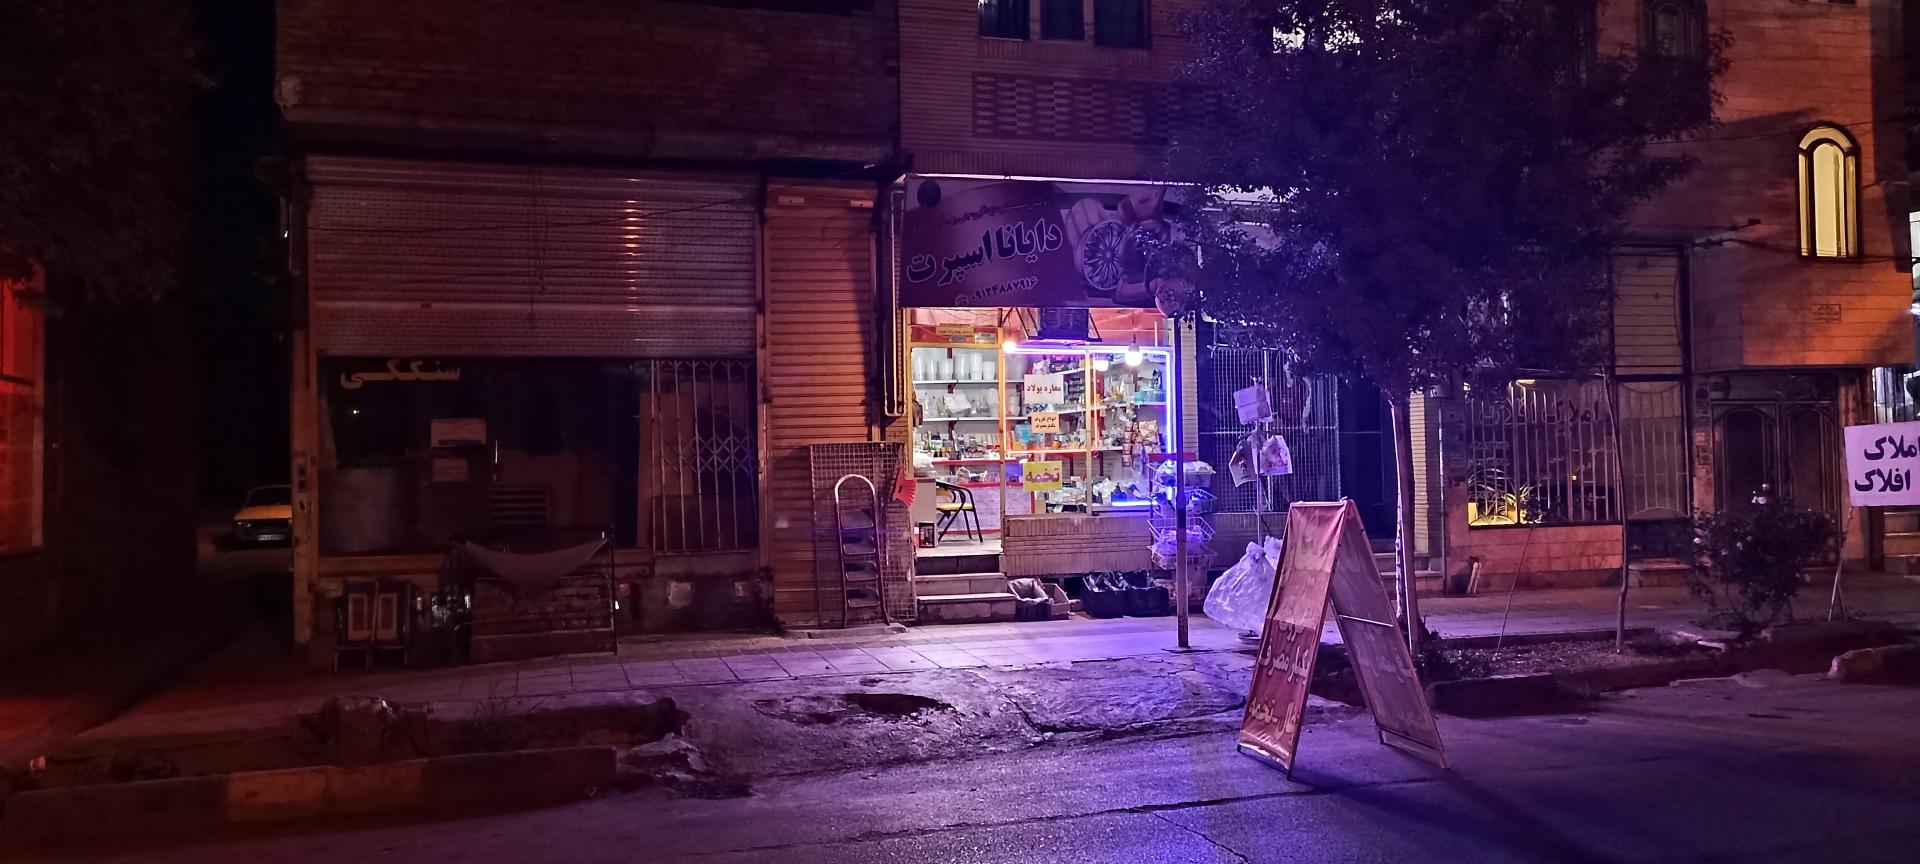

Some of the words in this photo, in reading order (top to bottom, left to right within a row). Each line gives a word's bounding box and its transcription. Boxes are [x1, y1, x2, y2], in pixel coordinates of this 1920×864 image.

[995, 217, 1063, 263] دایانا
[906, 229, 993, 287] اسپرت
[1025, 467, 1060, 483] تخمه
[1854, 468, 1911, 492] افلاک
